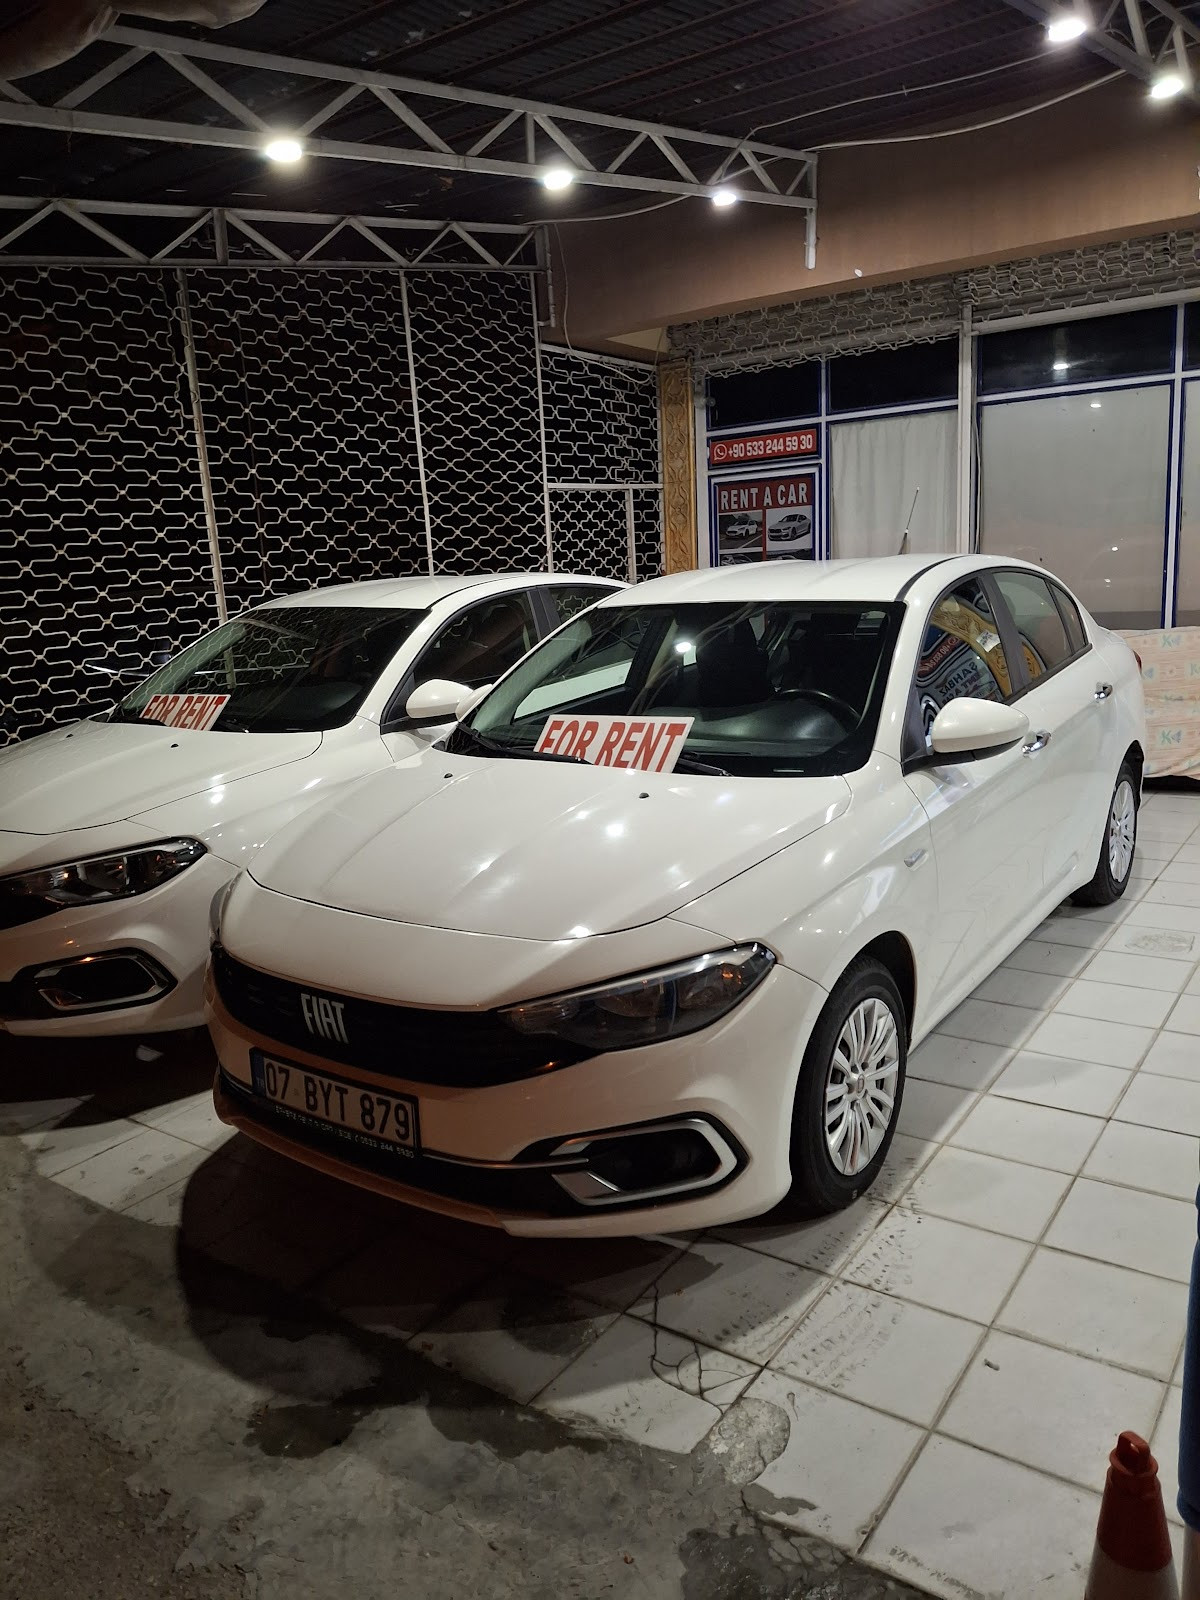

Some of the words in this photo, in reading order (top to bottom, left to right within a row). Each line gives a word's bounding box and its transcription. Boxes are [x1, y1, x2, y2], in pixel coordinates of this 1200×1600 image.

[728, 443, 745, 458] +90
[746, 440, 764, 456] 533
[766, 437, 784, 454] 244
[786, 435, 798, 451] 59
[800, 434, 813, 450] 30
[721, 487, 759, 511] RENT
[763, 486, 773, 507] A
[777, 482, 808, 505] CAR
[142, 695, 180, 722] FOR
[169, 695, 228, 731] RENT
[539, 720, 599, 760] FOR
[594, 722, 687, 773] RENT
[301, 992, 349, 1044] FIAT
[265, 1061, 290, 1100] 07
[304, 1075, 348, 1122] BYT
[359, 1093, 410, 1141] 879
